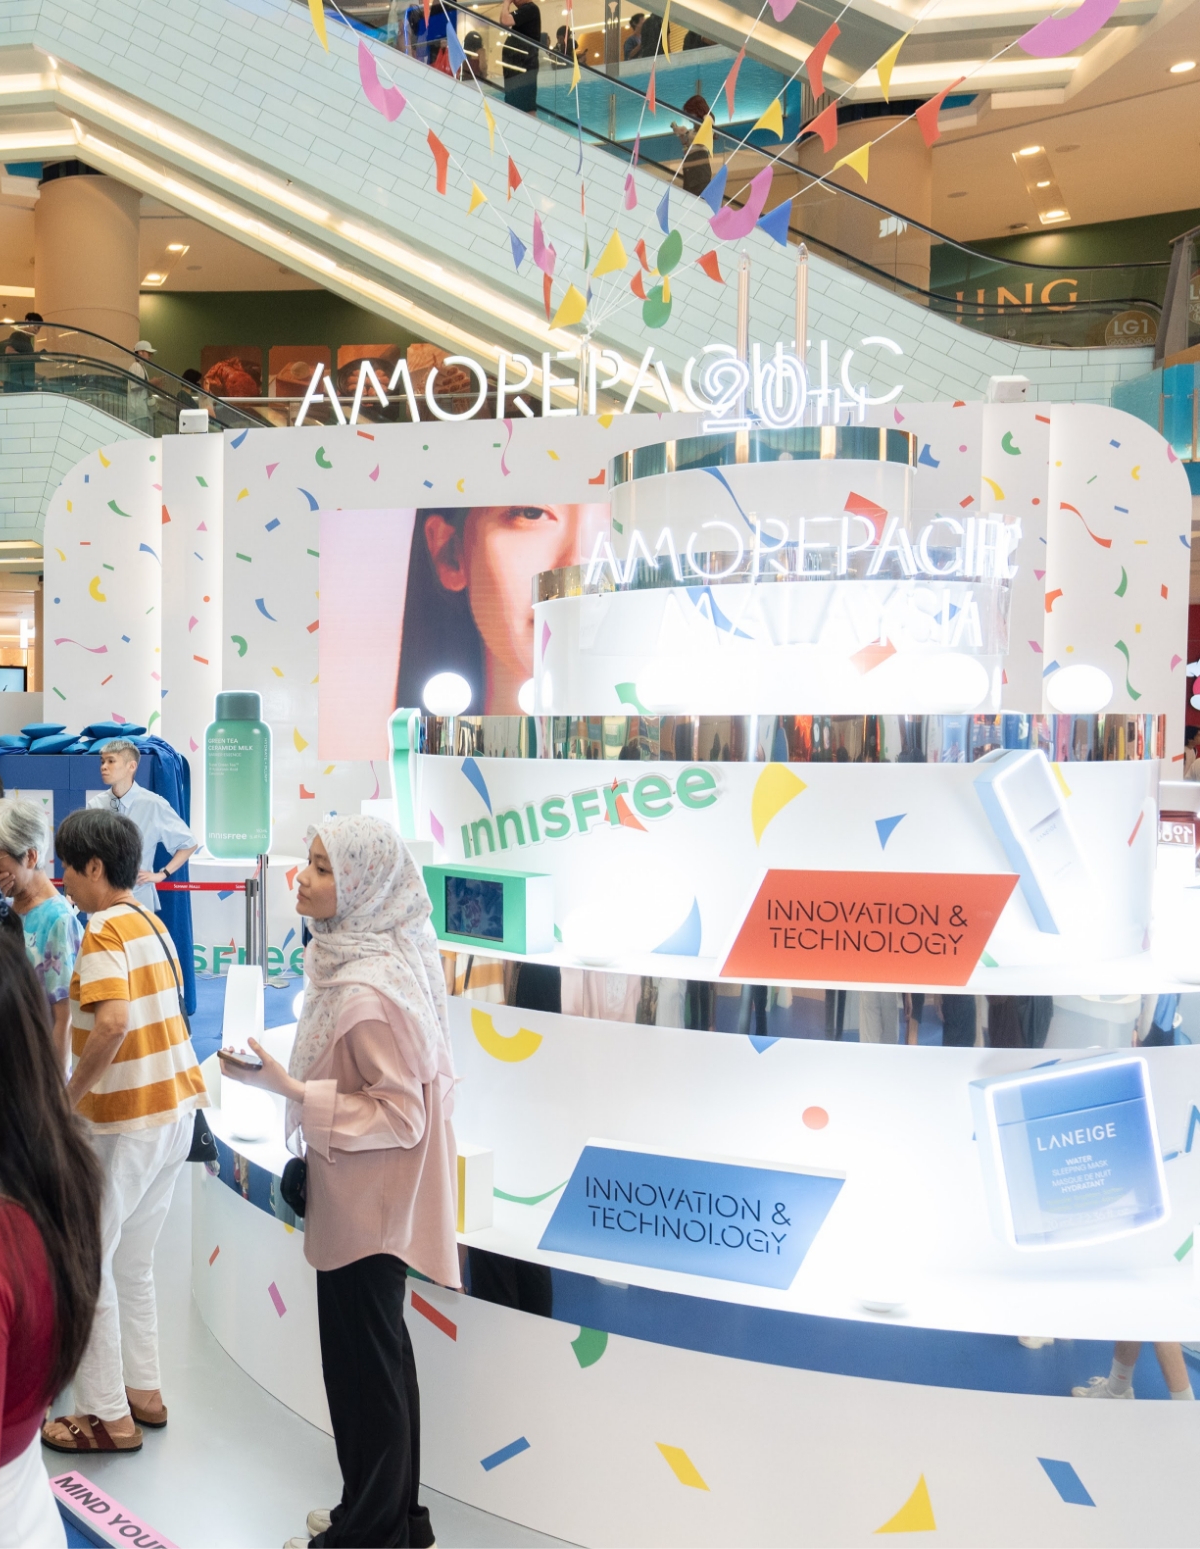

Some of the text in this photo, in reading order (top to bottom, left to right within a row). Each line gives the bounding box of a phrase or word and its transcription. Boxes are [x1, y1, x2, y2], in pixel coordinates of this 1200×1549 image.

[1113, 319, 1149, 336] LG1
[767, 899, 968, 927] INNOVATION &
[768, 927, 965, 956] TECHNOLOGY
[1036, 1122, 1117, 1152] LANEIGE
[1052, 1159, 1109, 1177] SLEEPING MASK
[1065, 1154, 1093, 1165] WATER
[1052, 1169, 1113, 1187] MASQUE DE NUIT
[1061, 1178, 1106, 1193] HYDRATANT
[584, 1175, 792, 1227] INNOVATION &
[587, 1204, 788, 1256] TECHNOLOGY
[54, 1476, 110, 1514] MIND
